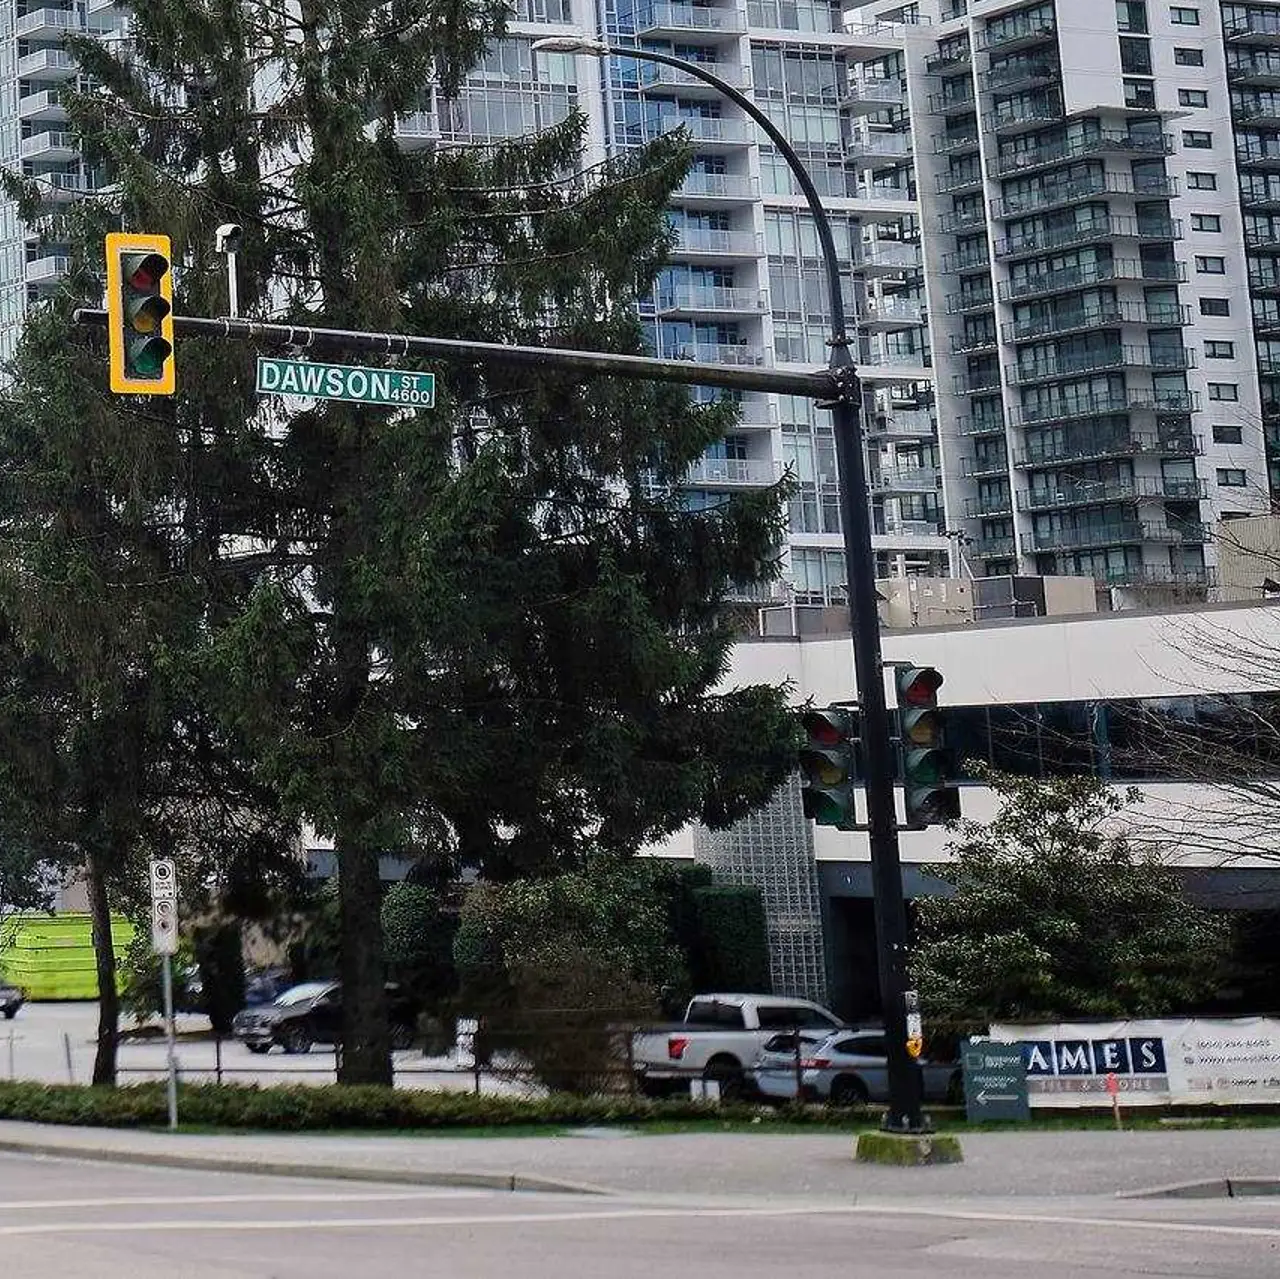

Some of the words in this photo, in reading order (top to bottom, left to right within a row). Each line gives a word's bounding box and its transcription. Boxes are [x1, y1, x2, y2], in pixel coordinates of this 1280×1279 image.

[261, 362, 390, 400] DAWSON
[401, 376, 420, 389] ST
[391, 389, 430, 404] 4600
[1026, 1040, 1157, 1070] AMES
[1099, 1079, 1152, 1091] SONE
